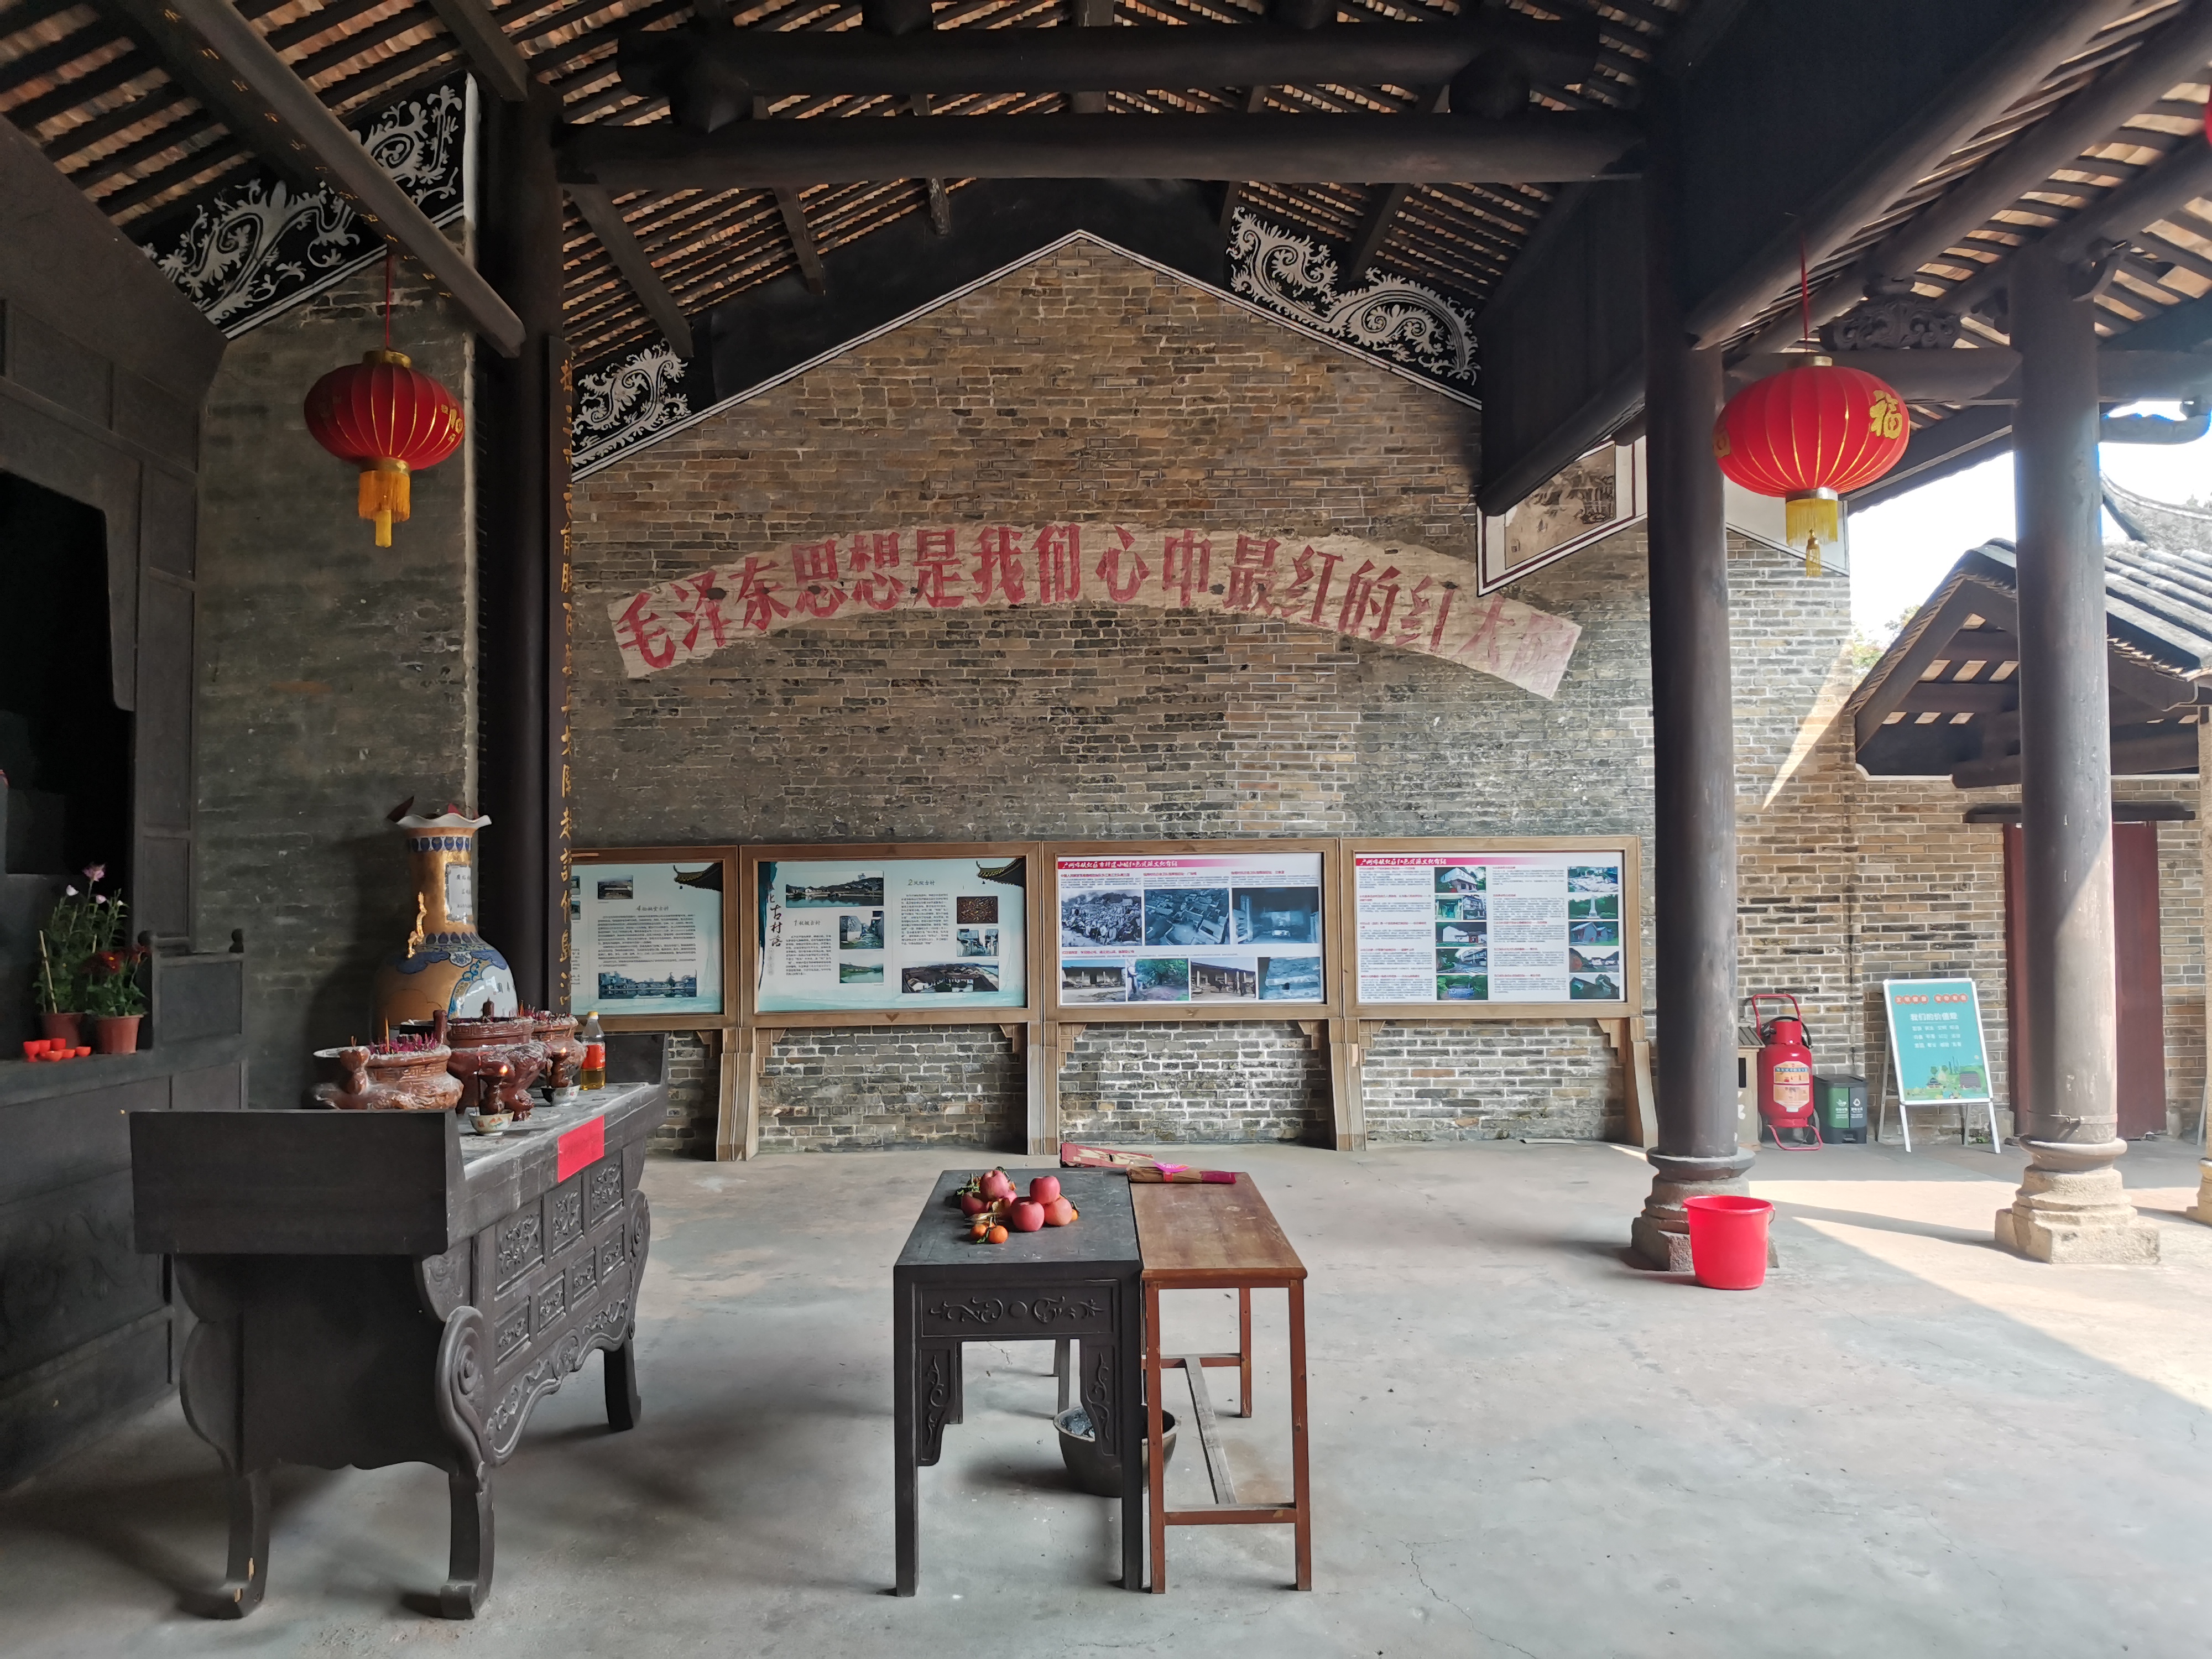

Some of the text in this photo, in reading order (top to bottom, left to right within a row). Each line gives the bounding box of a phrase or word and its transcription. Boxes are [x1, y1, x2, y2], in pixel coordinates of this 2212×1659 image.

[1869, 390, 1903, 440] 福
[1910, 1012, 1958, 1021] 我们的价值观
